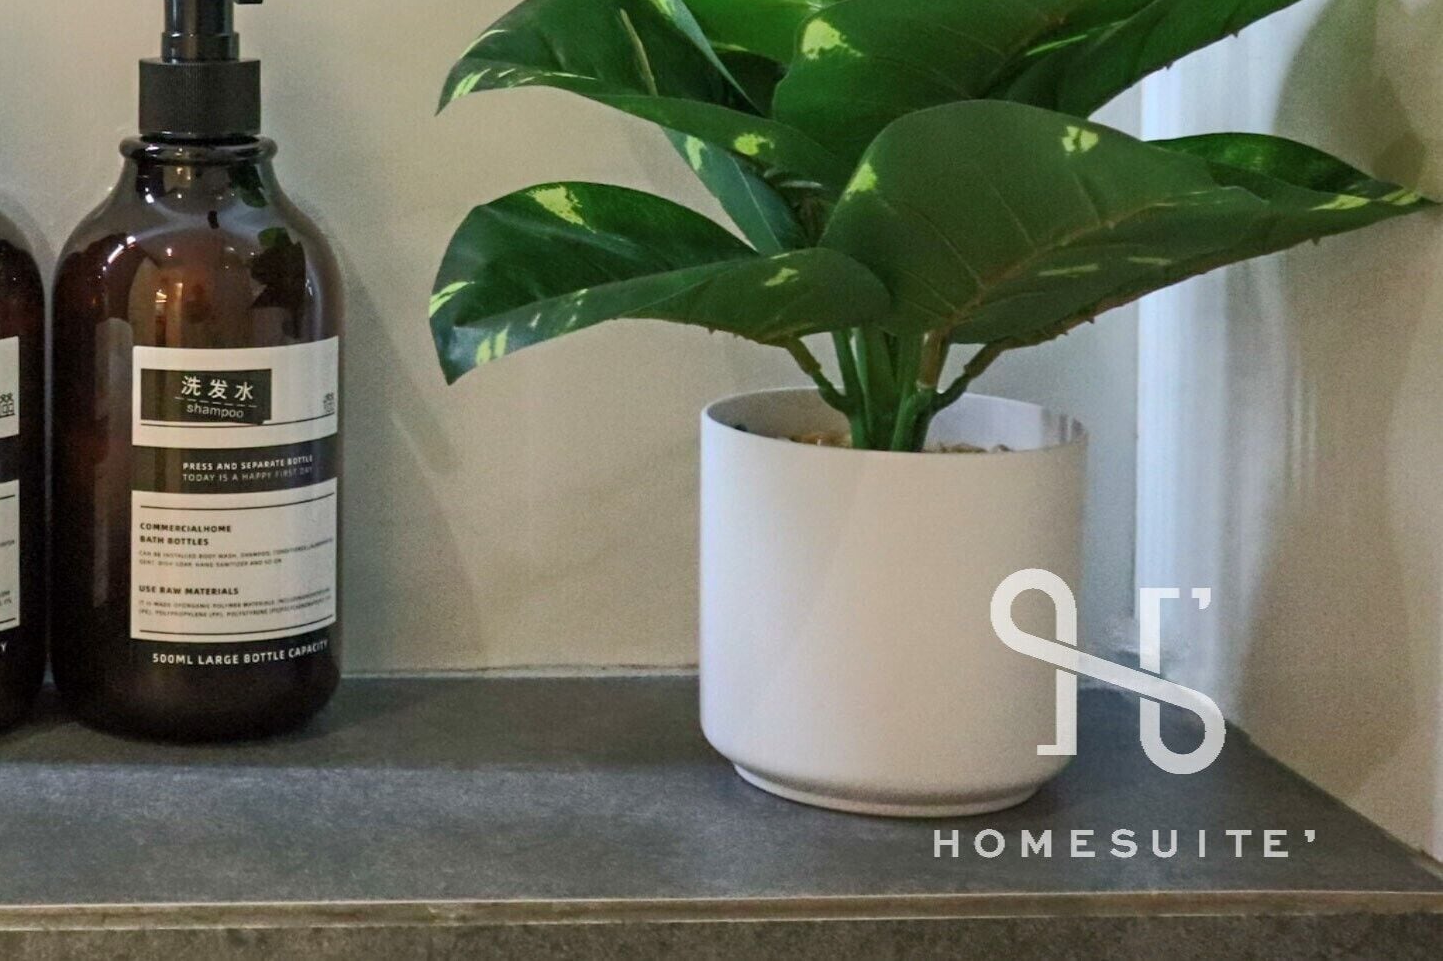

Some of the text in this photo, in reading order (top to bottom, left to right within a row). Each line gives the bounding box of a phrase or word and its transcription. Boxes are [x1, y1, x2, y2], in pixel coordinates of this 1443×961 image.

[181, 375, 255, 402] 洗发水
[187, 402, 244, 419] shampoo
[183, 455, 313, 471] PRESS AND SEPARATE BOTTLE
[183, 472, 215, 482] TODAY
[219, 472, 228, 482] IS
[231, 472, 239, 481] A
[242, 471, 272, 481] HAPPY
[275, 468, 297, 479] FIRST
[140, 522, 231, 533] COMMERCIALHOME
[139, 535, 209, 546] BATH BOTTLES
[139, 586, 239, 596] USE RAW MATERIALS
[152, 640, 329, 665] 500ML LARGE BOTTLE CAPACITY
